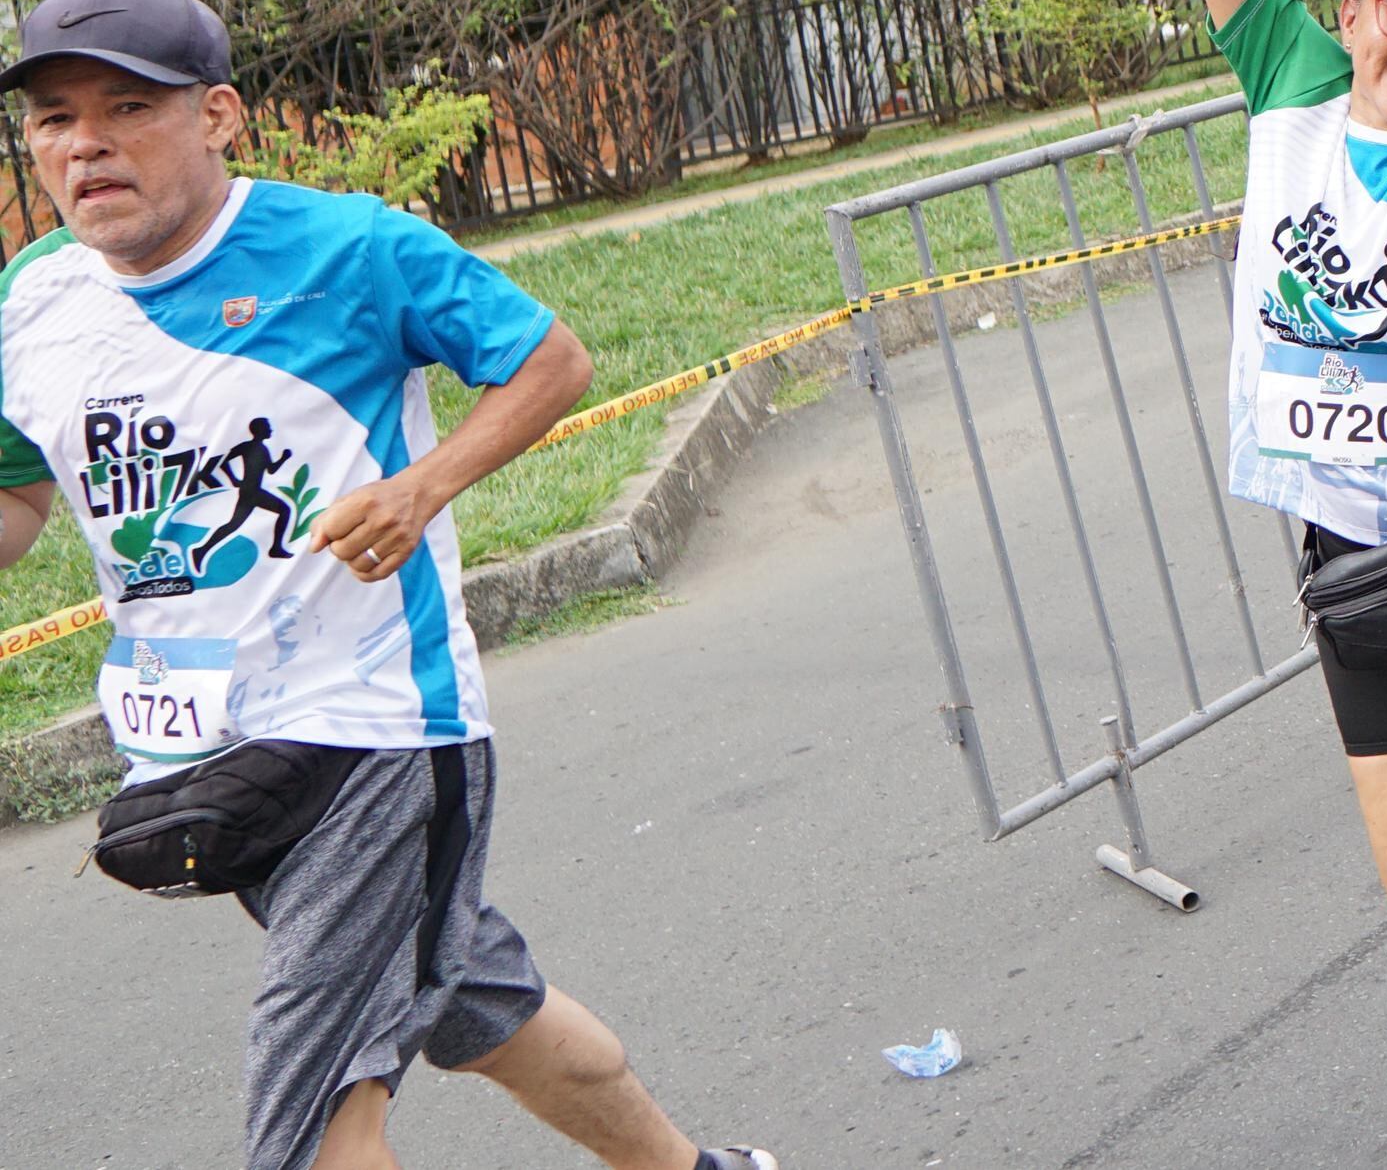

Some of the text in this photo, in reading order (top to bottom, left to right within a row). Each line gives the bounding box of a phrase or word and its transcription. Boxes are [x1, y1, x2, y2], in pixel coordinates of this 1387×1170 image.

[85, 393, 144, 410] Carrera
[85, 406, 176, 463] Río
[122, 692, 202, 738] 0721
